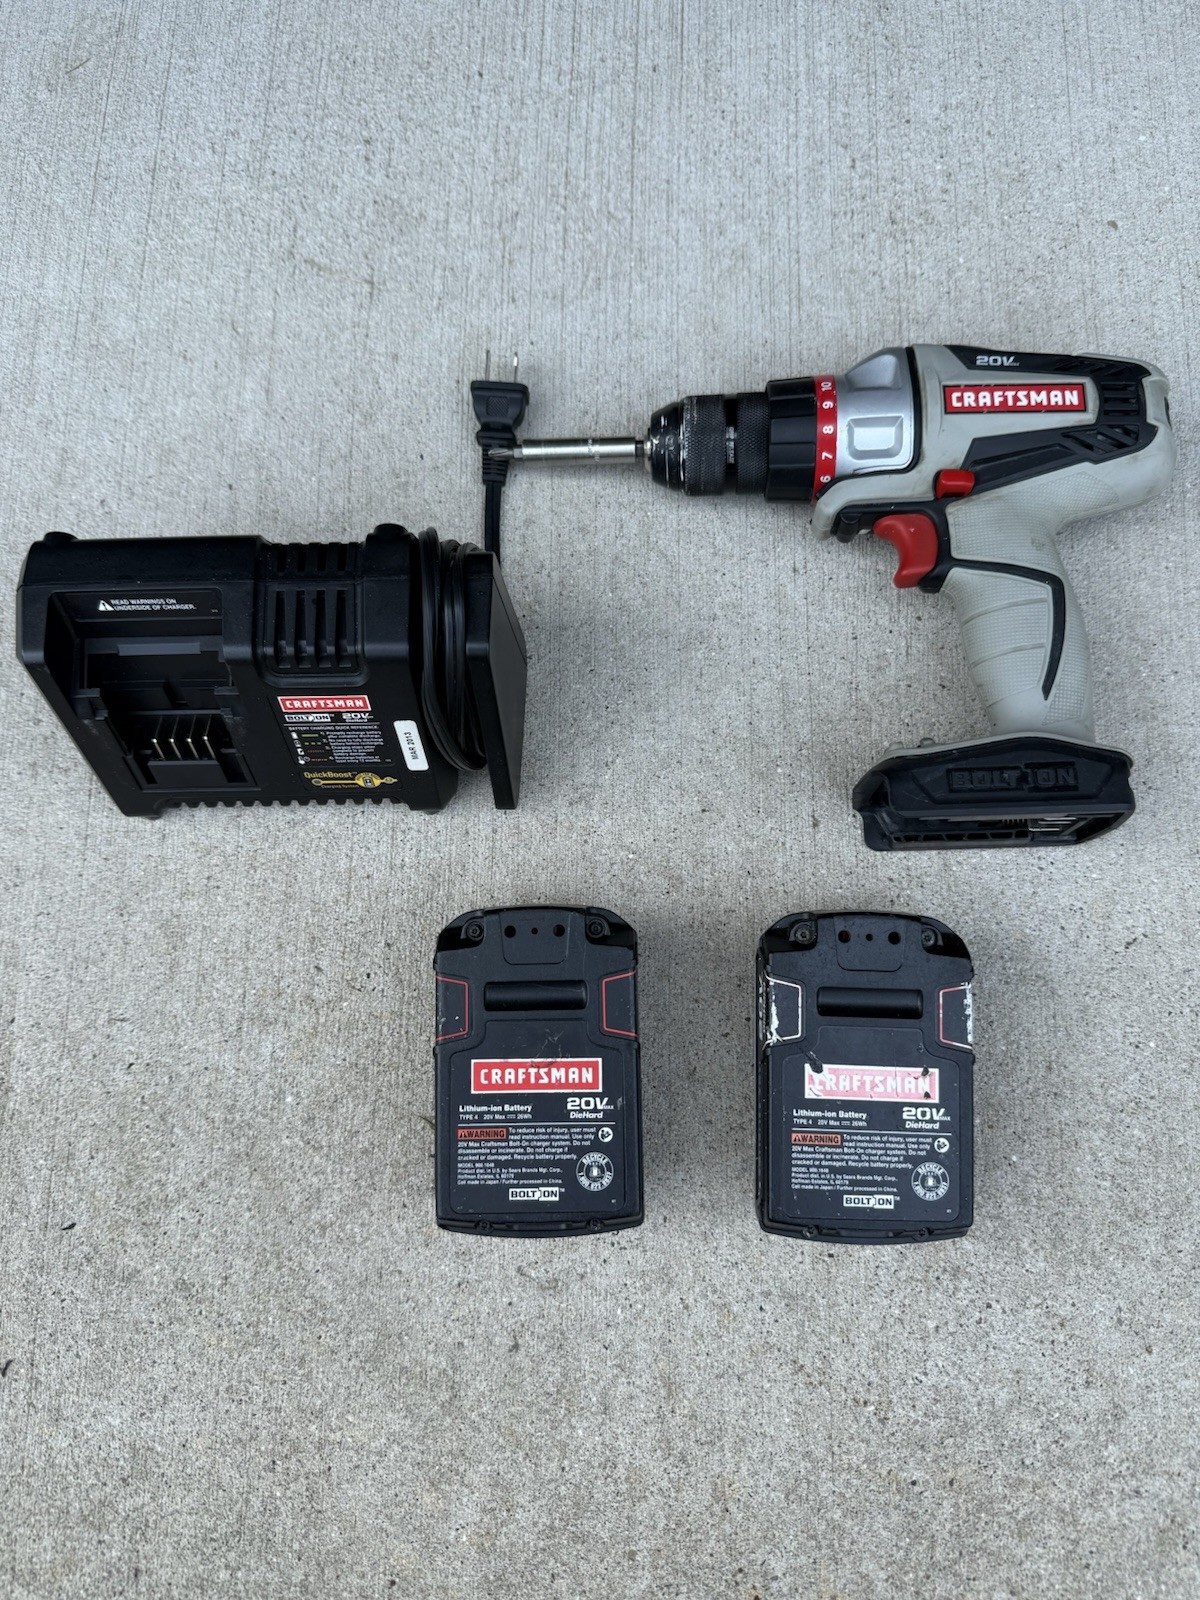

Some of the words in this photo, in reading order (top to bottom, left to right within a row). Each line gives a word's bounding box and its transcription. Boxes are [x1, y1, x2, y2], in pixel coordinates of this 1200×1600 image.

[976, 355, 1014, 367] 20V
[822, 382, 832, 392] 10
[951, 390, 1079, 408] CRAFTSMAN
[823, 400, 833, 410] 9
[823, 425, 834, 435] 8
[822, 452, 833, 460] 7
[820, 475, 831, 484] 6
[285, 700, 364, 708] CRAFTSMAN
[404, 732, 414, 745] 2013
[411, 747, 419, 760] MAR
[952, 771, 1021, 788] BOLT
[1037, 768, 1076, 786] ON
[480, 1067, 593, 1084] CRAFTSMAN
[459, 1104, 502, 1112] Lithium-ion
[504, 1104, 532, 1112] Battery
[567, 1097, 609, 1110] 20V
[570, 1111, 603, 1119] DieHard
[793, 1109, 837, 1118] Lithium-ion
[839, 1110, 867, 1120] Battery
[903, 1107, 945, 1121] 20V
[906, 1121, 939, 1130] DieHard
[467, 1130, 505, 1138] WARNING
[801, 1135, 839, 1144] WARNING
[582, 1154, 608, 1164] RECYCLE
[917, 1163, 943, 1174] RECYCLE
[511, 1190, 537, 1198] BOLT
[543, 1190, 558, 1198] ON
[845, 1197, 871, 1205] BOLT
[878, 1198, 892, 1206] ON
